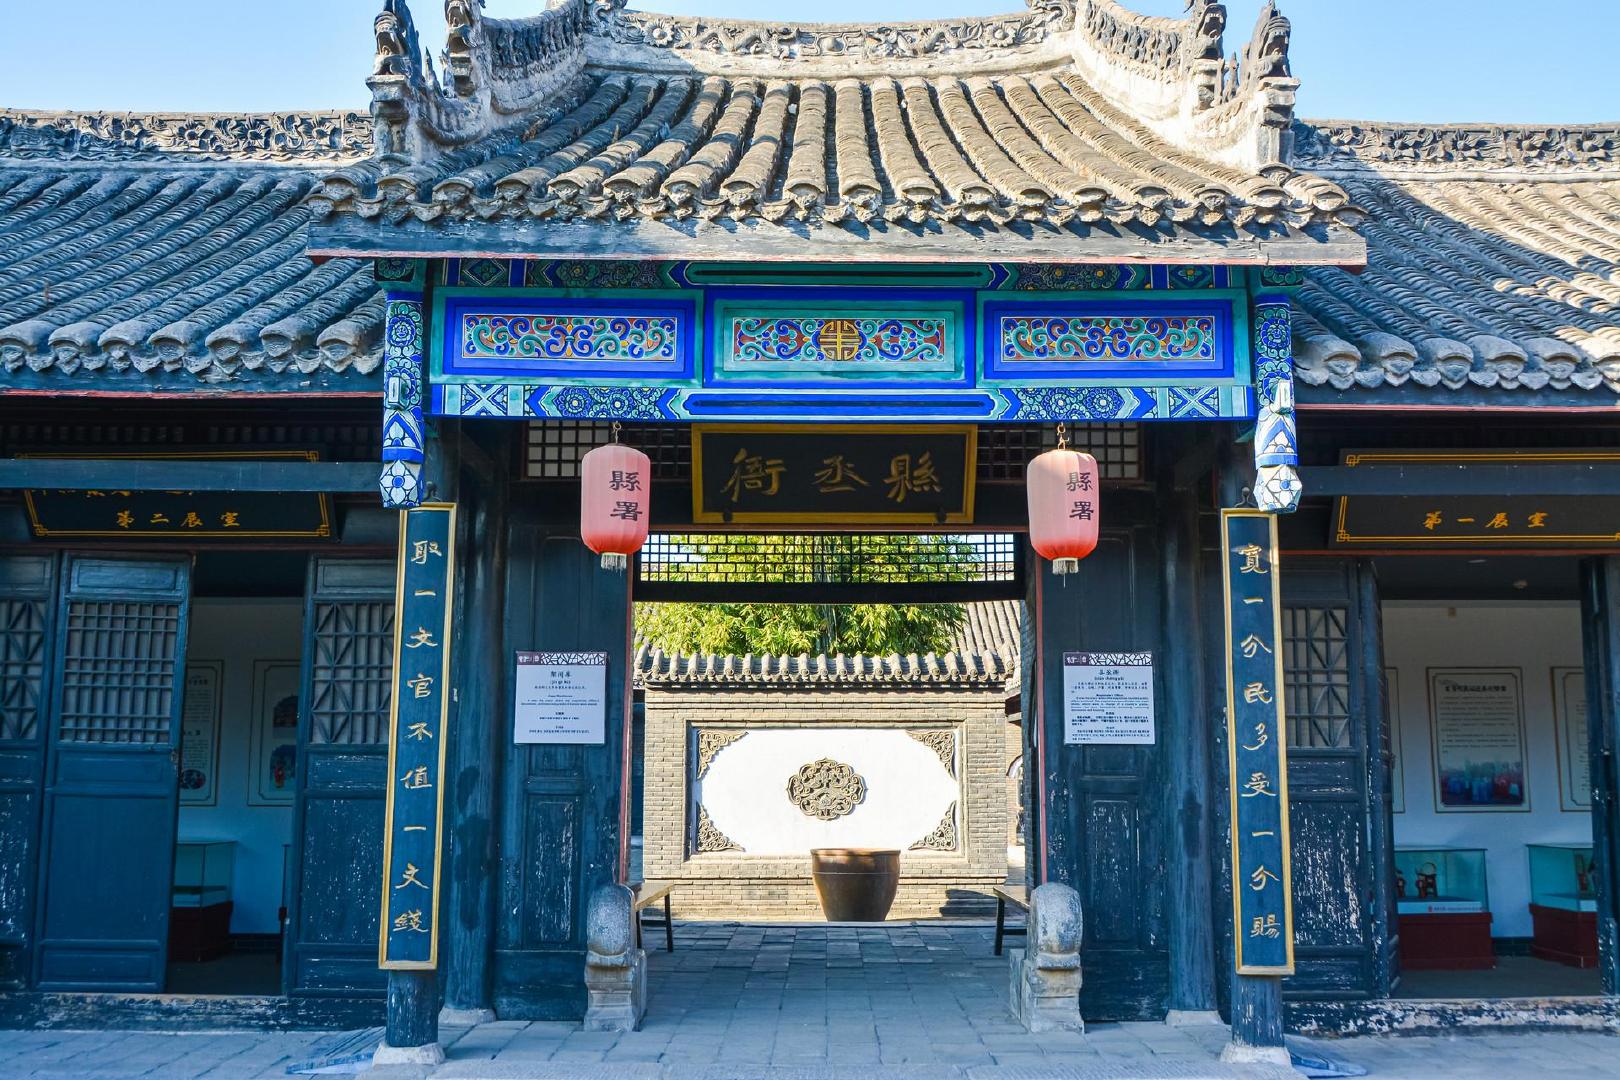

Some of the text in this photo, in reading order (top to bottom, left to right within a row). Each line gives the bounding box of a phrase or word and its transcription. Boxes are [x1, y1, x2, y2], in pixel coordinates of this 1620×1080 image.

[609, 470, 643, 522] 縣署
[1066, 471, 1095, 521] 縣署
[116, 509, 241, 529] 第二展室
[1422, 509, 1549, 530] 第一展室
